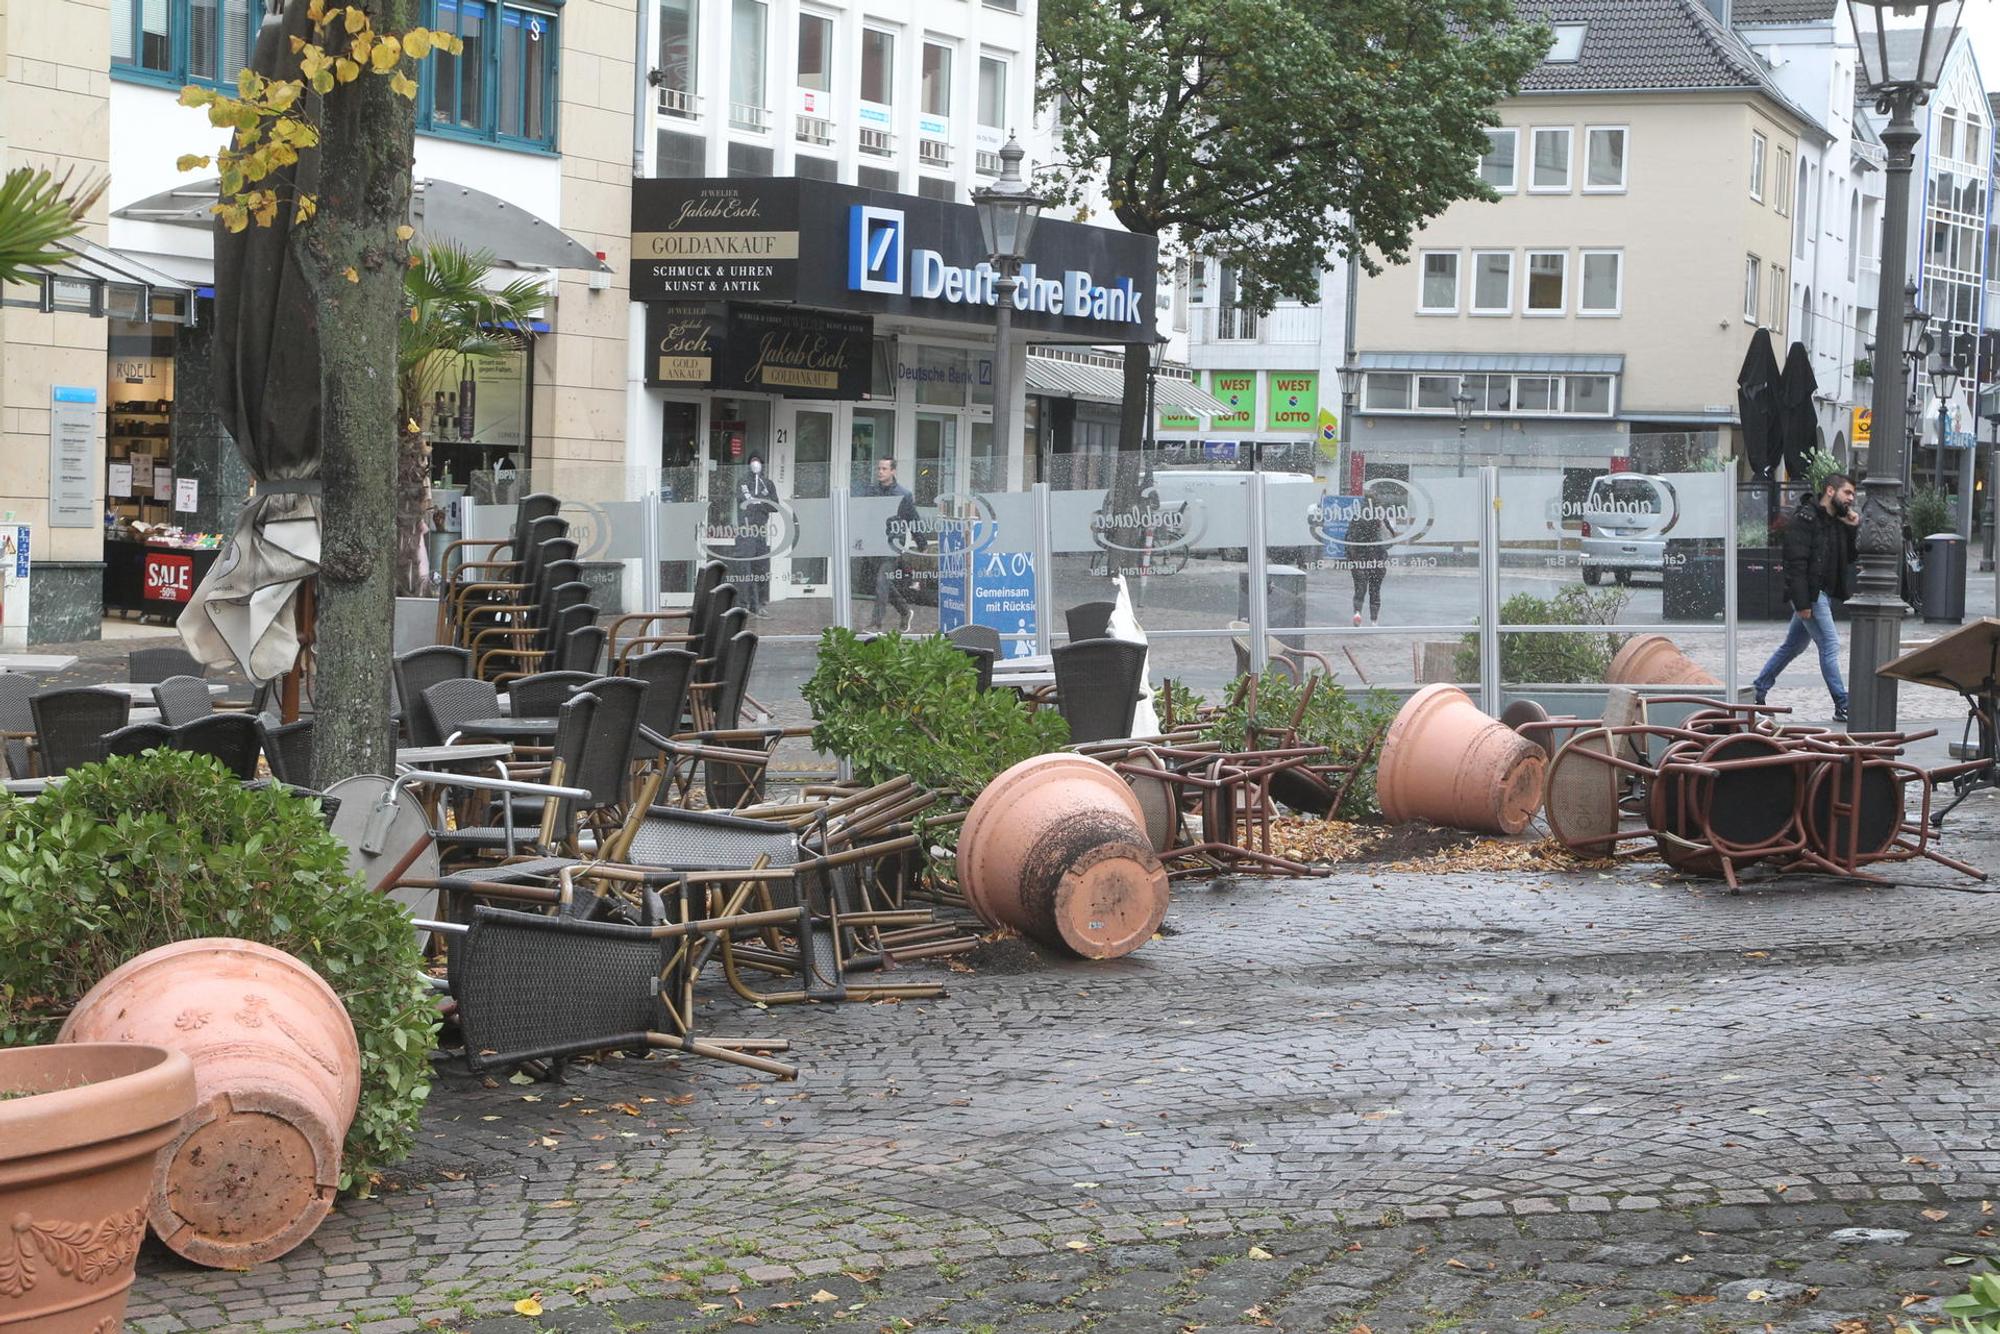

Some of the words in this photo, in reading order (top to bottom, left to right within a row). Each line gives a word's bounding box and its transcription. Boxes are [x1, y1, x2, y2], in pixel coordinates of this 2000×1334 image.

[700, 189, 739, 197] JUWELIER
[668, 198, 723, 230] Jakob
[652, 236, 777, 255] GOLDANKAUF
[653, 265, 712, 277] SCHMUCK
[716, 266, 725, 276] &
[730, 265, 774, 277] UHREN
[664, 281, 704, 292] KUNST
[708, 281, 717, 291] &
[723, 281, 760, 292] ANTIK
[911, 249, 1064, 316] Deutche
[1064, 270, 1142, 324] Bank
[672, 358, 699, 368] GOLD
[744, 331, 808, 383] Jakob
[668, 368, 705, 378] ANKAUF
[770, 370, 830, 387] GOLDANKAUF
[898, 362, 946, 382] Deutsche
[948, 366, 974, 383] Bank
[1220, 379, 1251, 391] WEST
[1277, 379, 1312, 392] WEST
[1275, 411, 1311, 423] LOTTO
[776, 429, 788, 444] 21
[148, 562, 190, 590] SALE
[975, 586, 1030, 598] Gemeinsam
[985, 601, 1001, 612] mit
